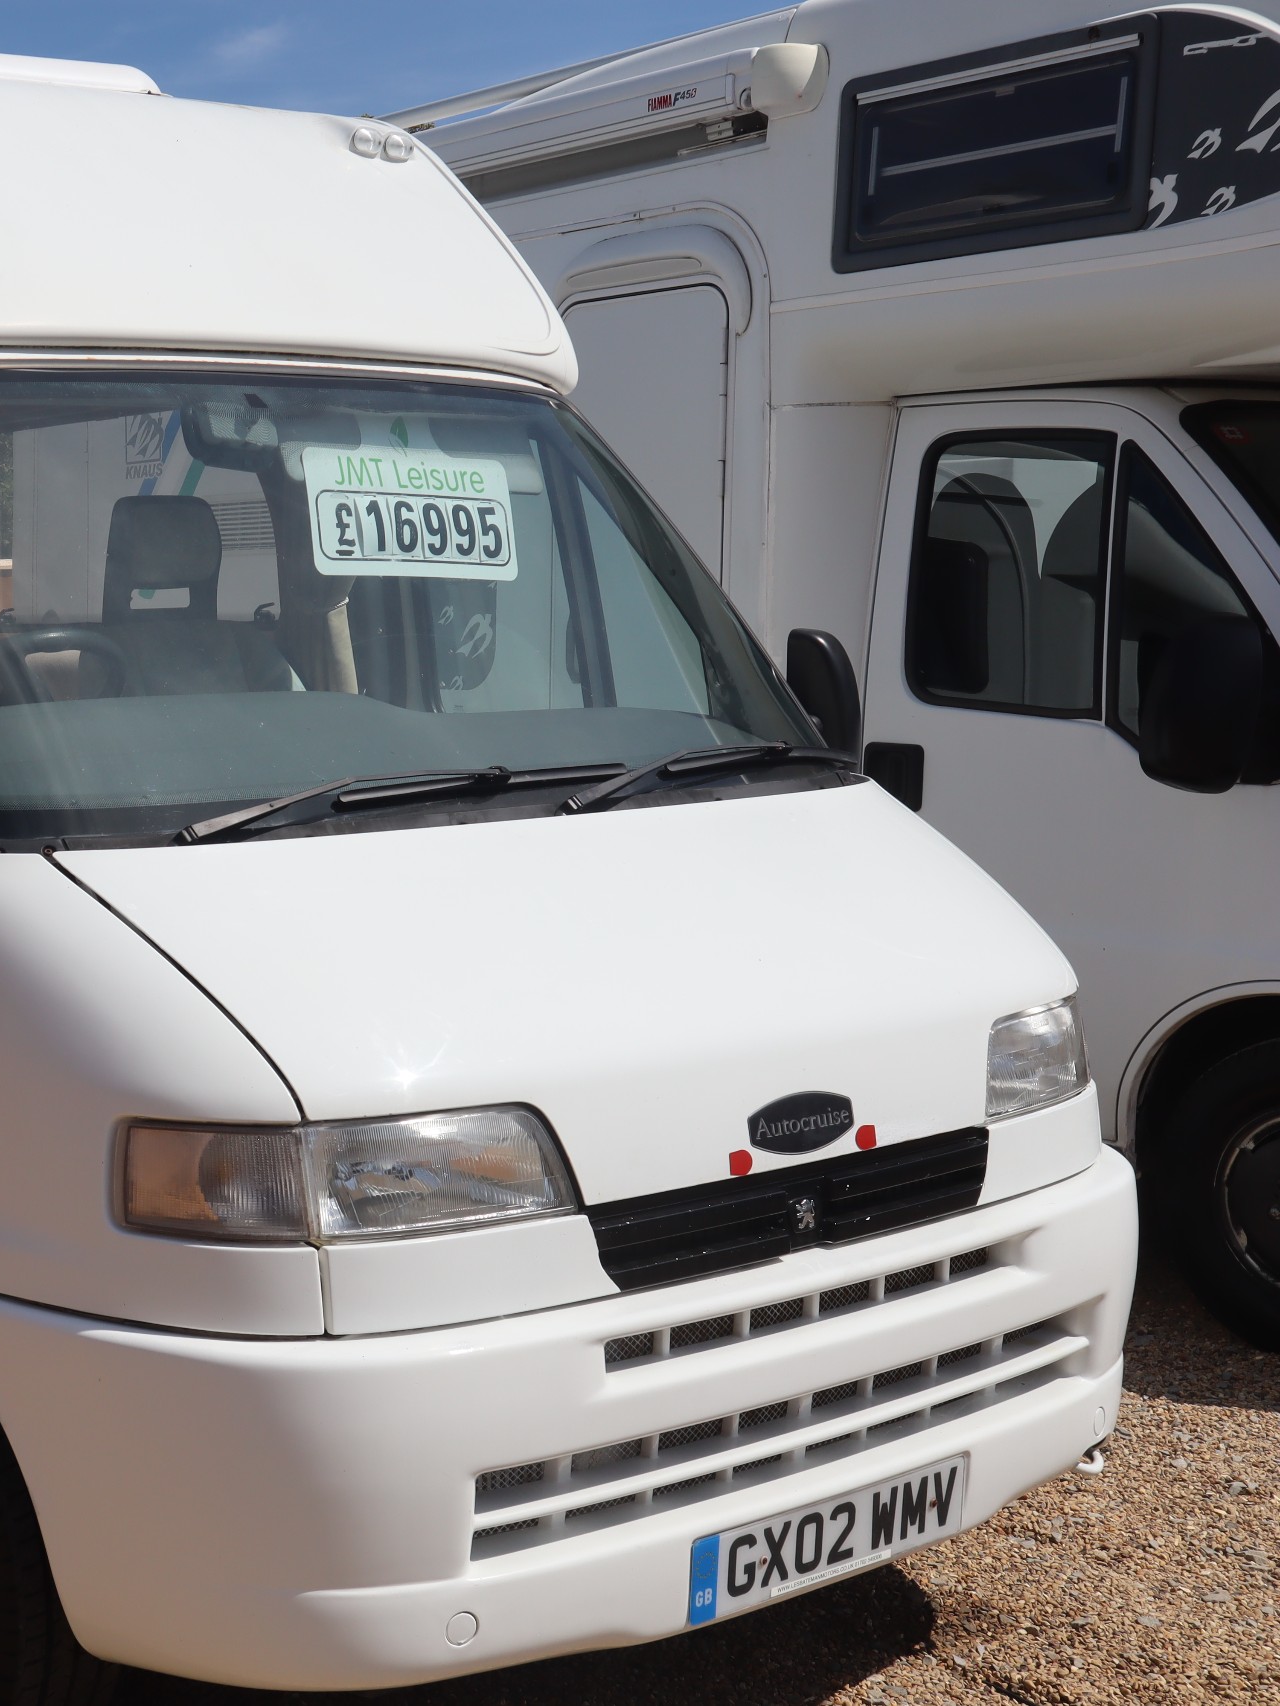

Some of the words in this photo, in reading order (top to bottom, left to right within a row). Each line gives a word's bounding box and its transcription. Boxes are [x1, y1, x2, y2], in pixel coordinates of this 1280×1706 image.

[647, 94, 672, 112] FIAMMA
[125, 462, 163, 480] KNAUS
[335, 455, 384, 487] JMT
[393, 459, 485, 493] Leisure
[335, 499, 503, 559] £16995
[755, 1107, 850, 1140] Autocruise
[726, 1501, 857, 1598] GX02
[871, 1466, 958, 1551] WMV
[694, 1587, 713, 1608] GB
